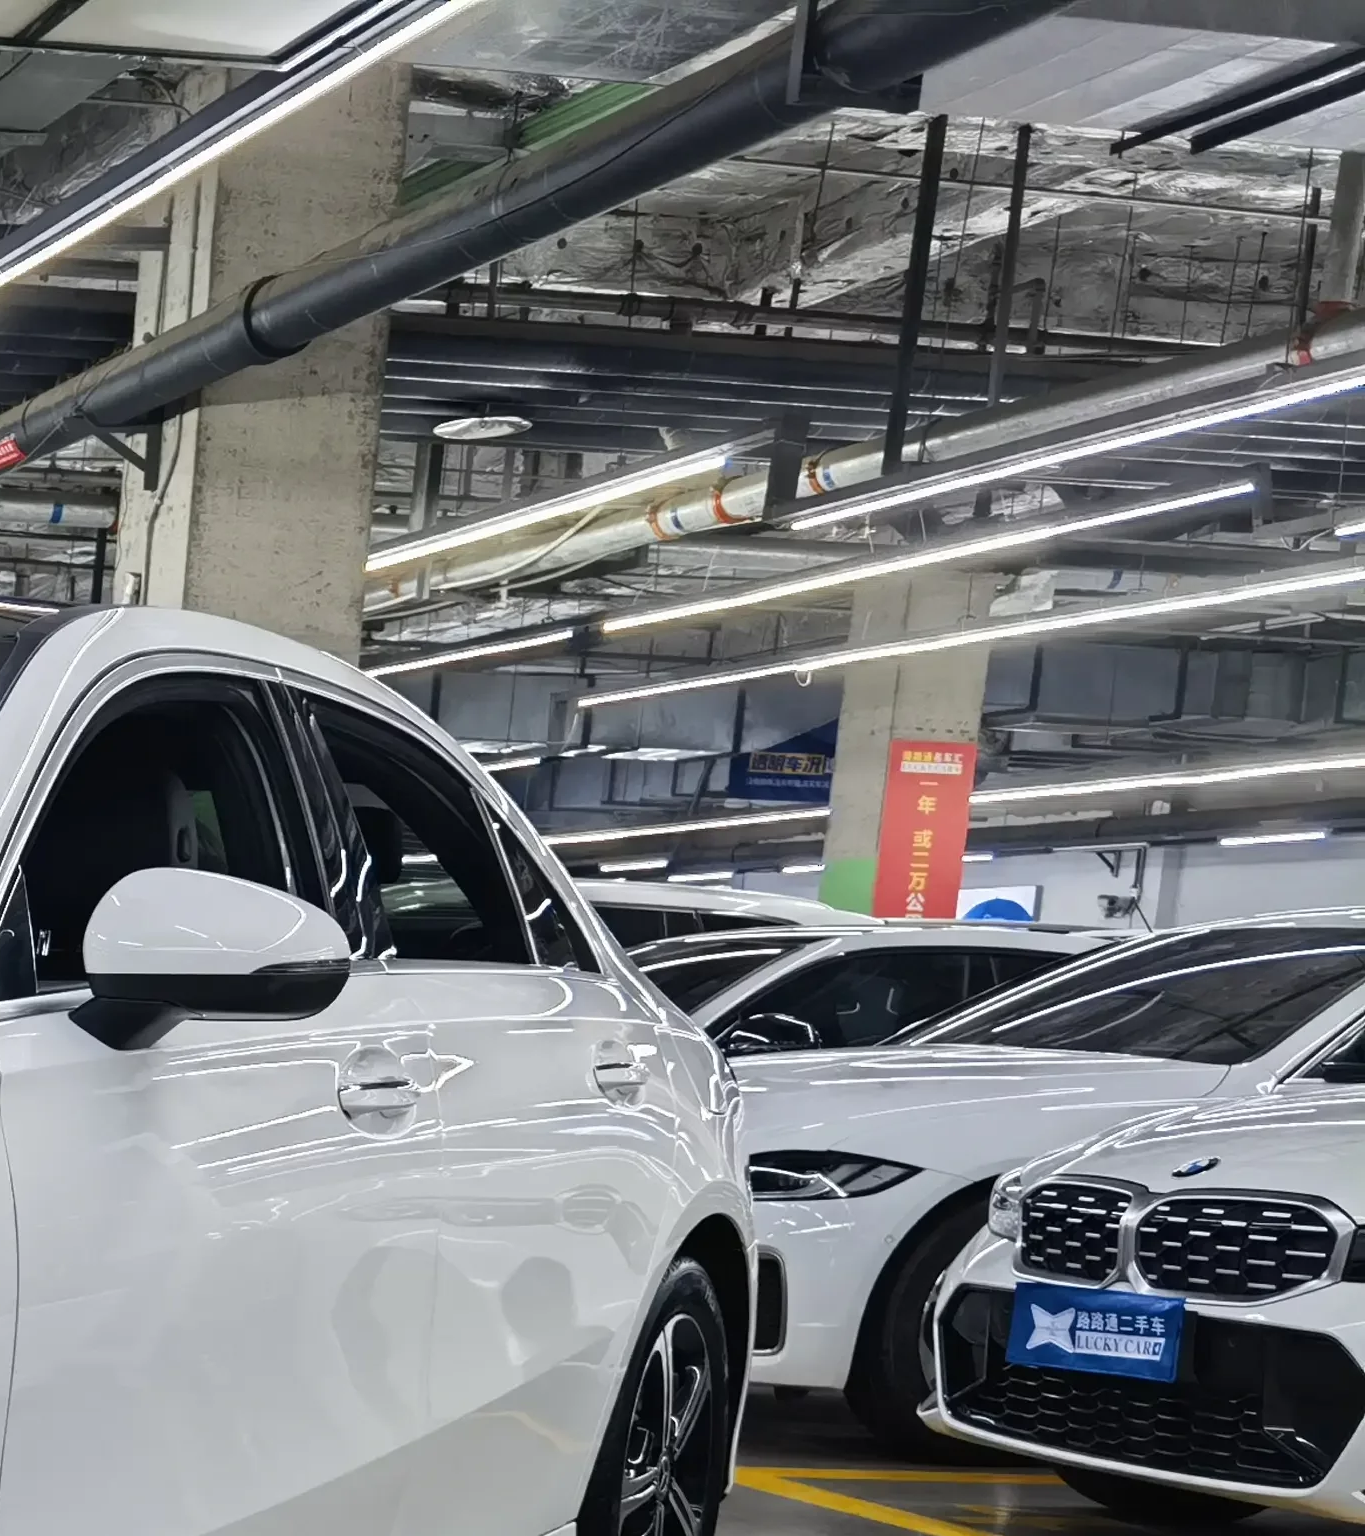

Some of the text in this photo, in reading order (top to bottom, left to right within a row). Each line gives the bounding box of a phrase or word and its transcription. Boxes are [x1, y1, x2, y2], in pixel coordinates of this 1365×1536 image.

[1076, 1311, 1166, 1336] 路路通二手车
[1076, 1334, 1153, 1356] LUCKY CAR
